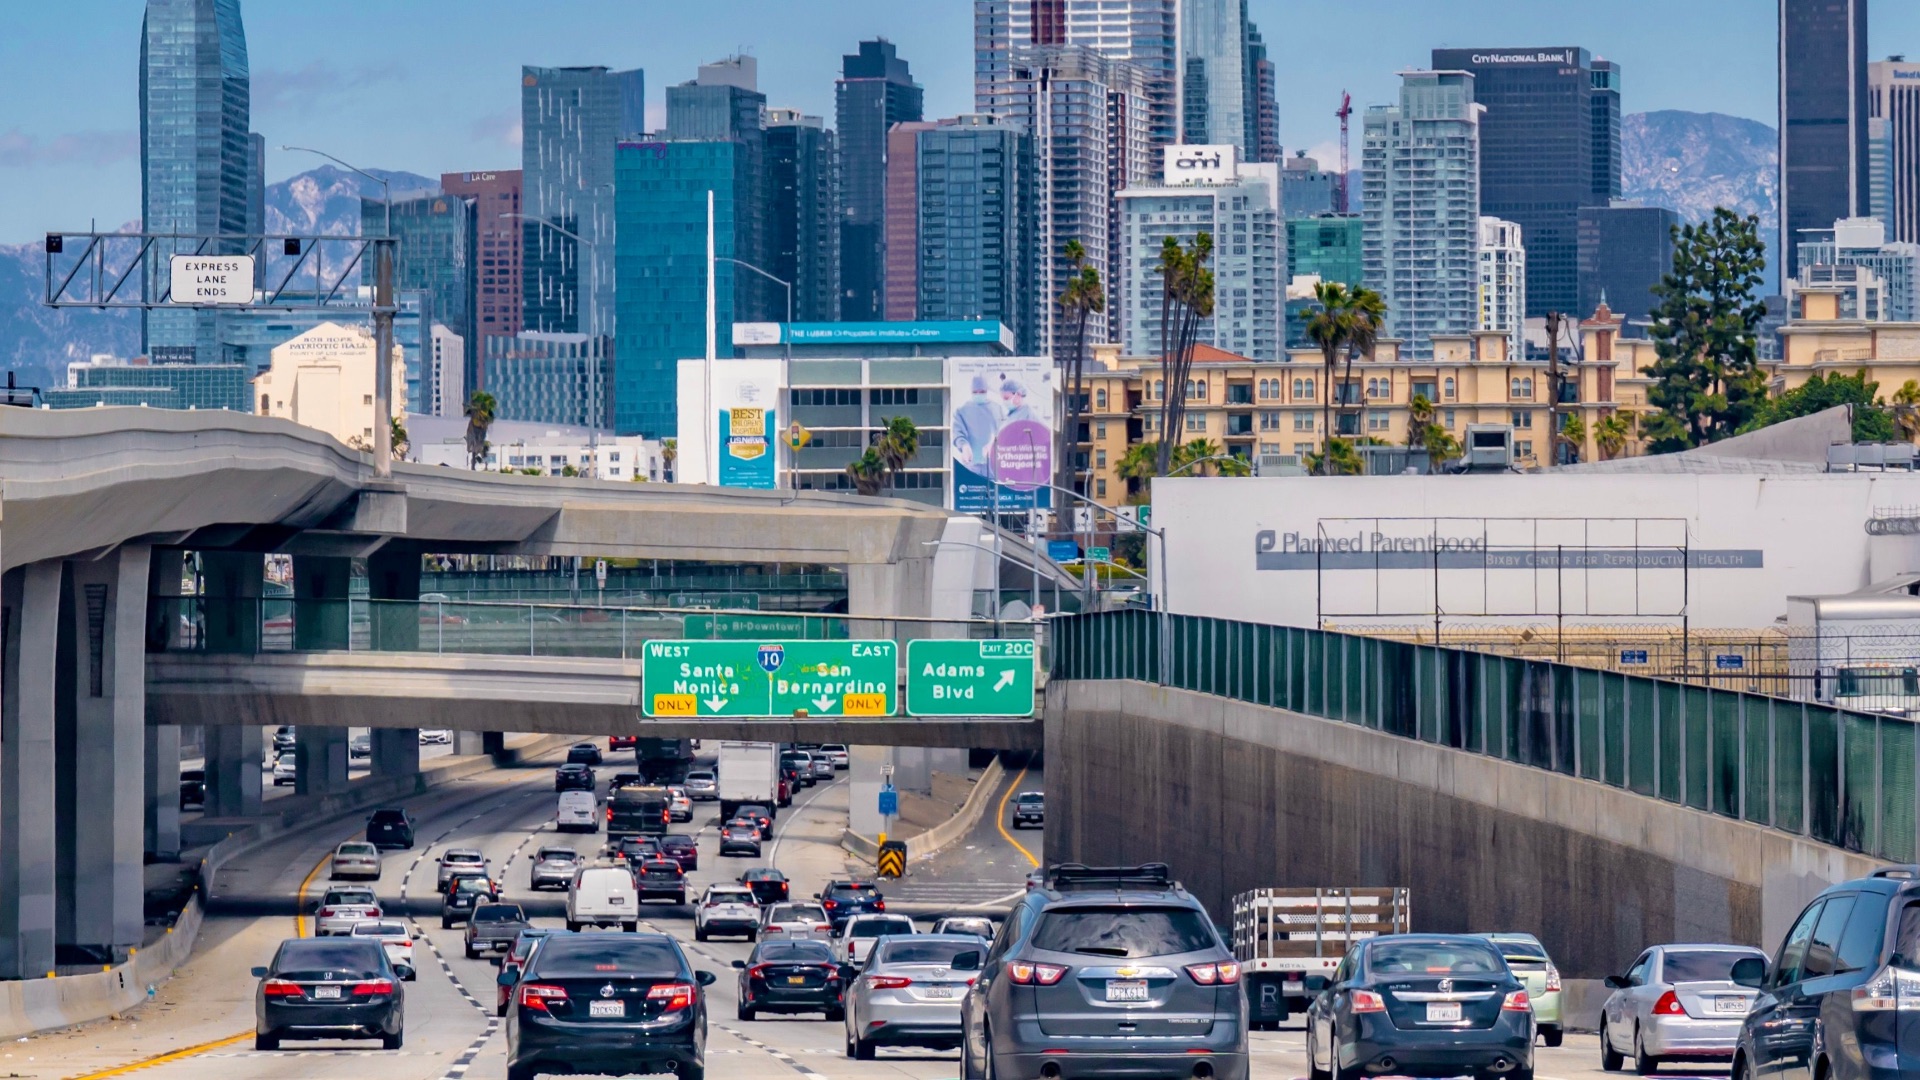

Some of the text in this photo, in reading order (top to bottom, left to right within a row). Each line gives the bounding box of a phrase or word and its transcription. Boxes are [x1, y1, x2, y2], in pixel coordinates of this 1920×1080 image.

[1472, 53, 1564, 63] CITY NATIONAL BANK
[481, 172, 496, 181] Care
[185, 262, 239, 271] EXPRESS
[197, 275, 227, 284] LANE
[197, 288, 227, 296] ENDS
[912, 329, 939, 337] Children
[732, 409, 763, 419] BEST
[1283, 532, 1488, 553] Planned Parenthood
[1486, 554, 1520, 566] BIXBY
[1575, 554, 1598, 566] FOR
[1603, 554, 1692, 566] REPRODUCTIVE
[1698, 554, 1744, 566] HEALTH
[705, 622, 728, 631] Pco
[650, 643, 691, 658] WEST
[851, 643, 891, 657] EAST
[982, 643, 1033, 655] EXIT 20C
[764, 652, 780, 667] 10
[680, 662, 734, 678] Santa
[817, 662, 851, 677] San
[922, 662, 986, 677] Adams
[673, 680, 740, 695] Monica
[777, 680, 887, 694] Bernardino
[932, 684, 974, 699] Blvd
[657, 700, 693, 711] ONLY
[846, 698, 882, 709] ONLY
[1261, 985, 1277, 1003] R
